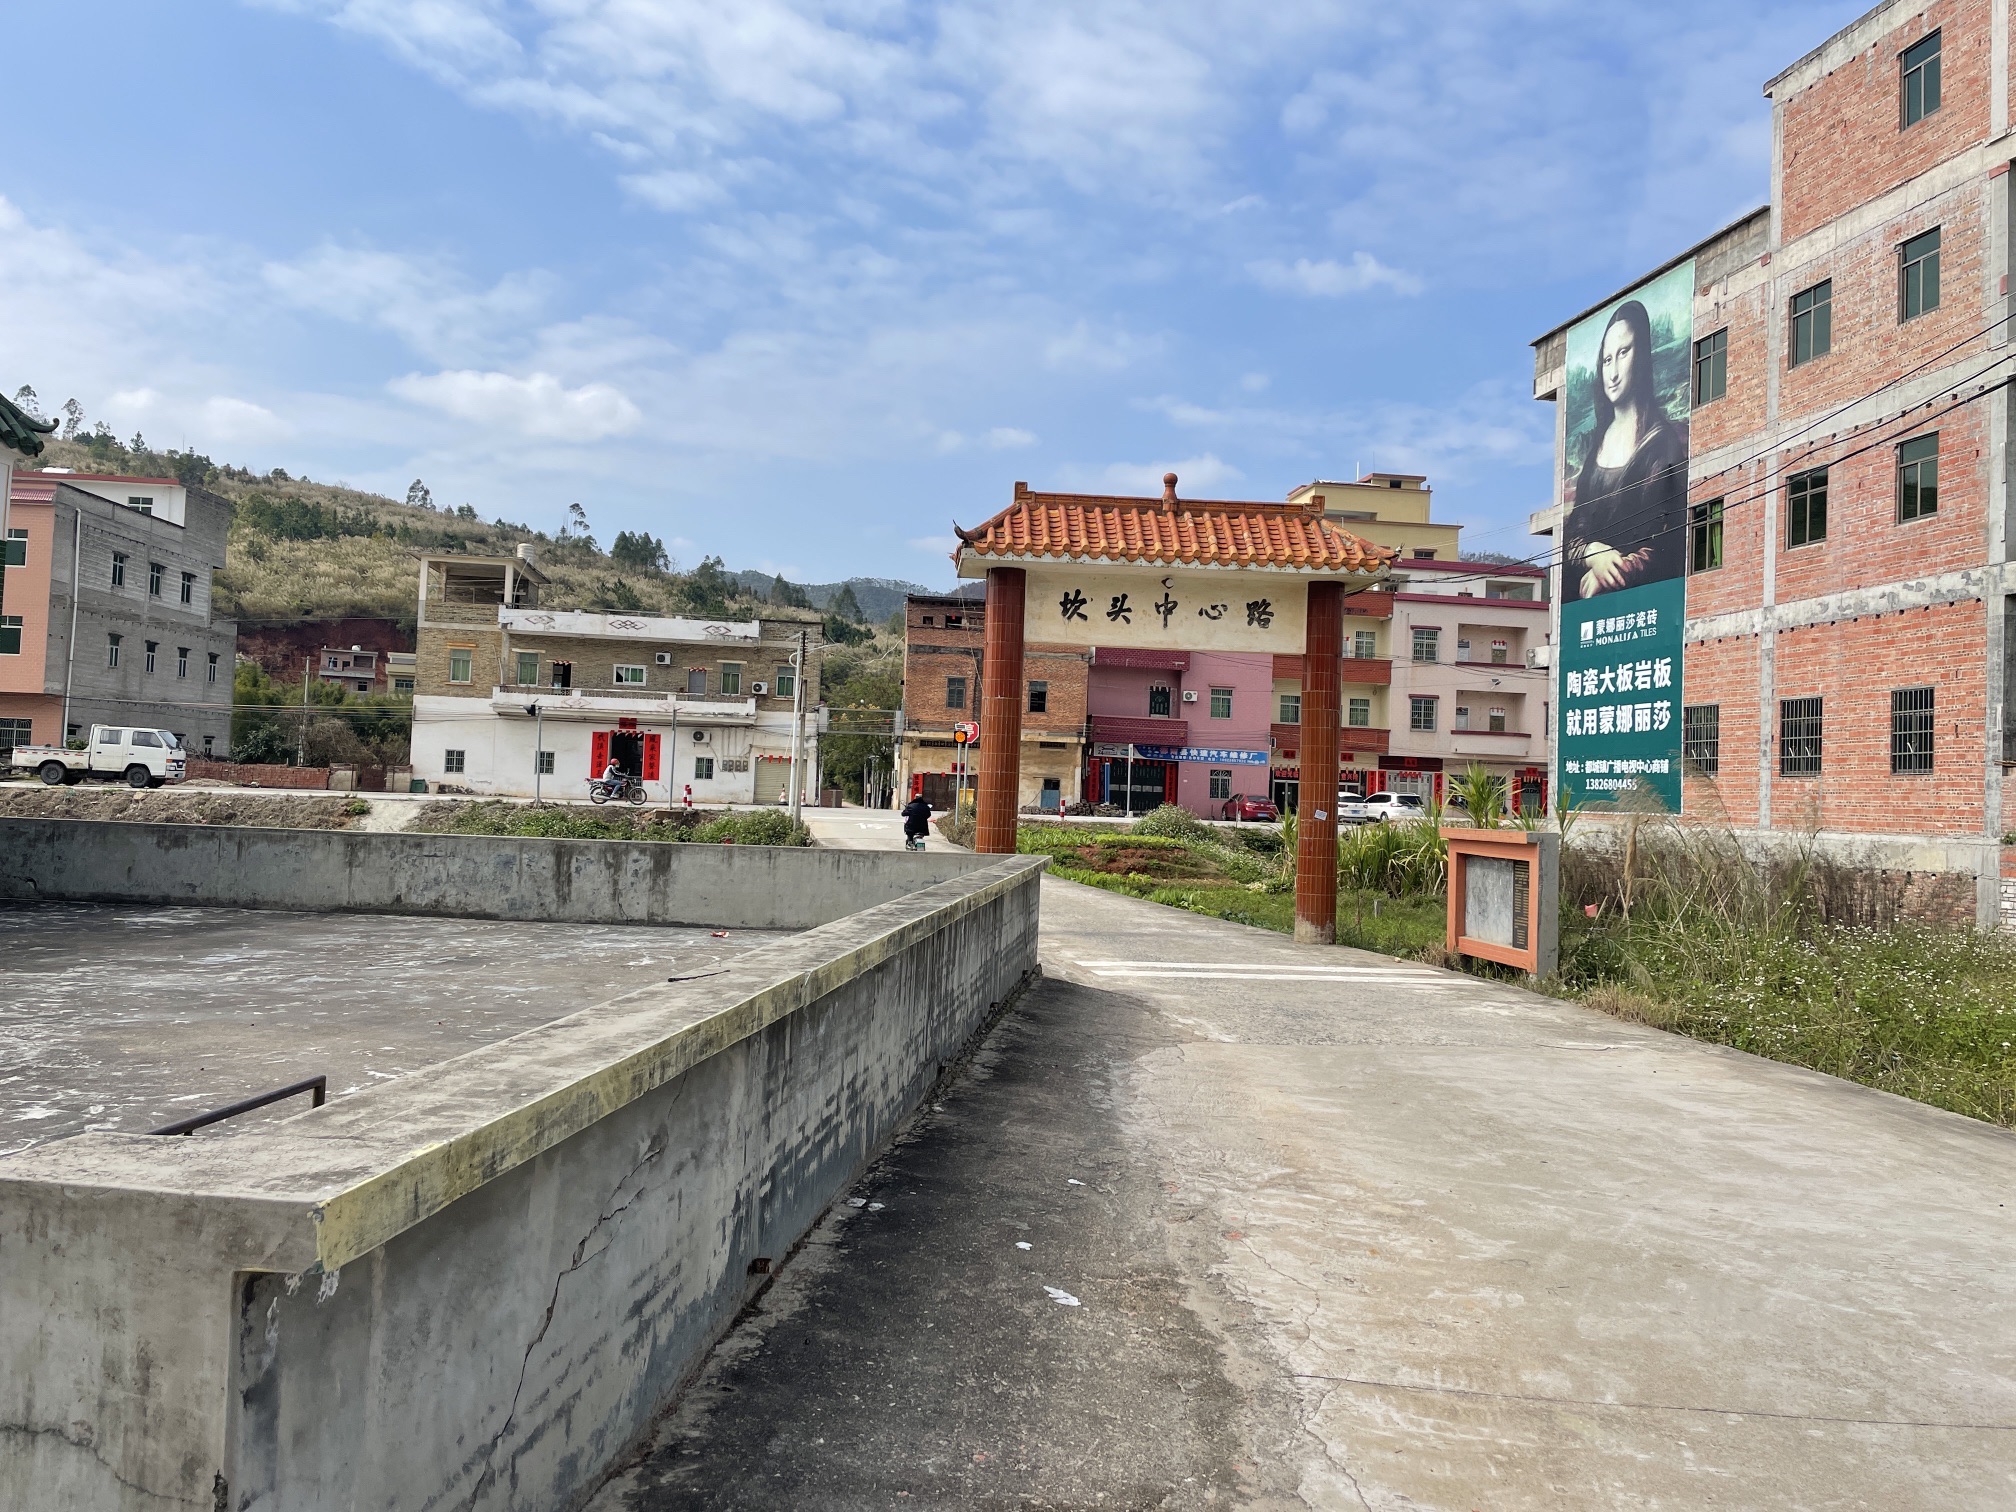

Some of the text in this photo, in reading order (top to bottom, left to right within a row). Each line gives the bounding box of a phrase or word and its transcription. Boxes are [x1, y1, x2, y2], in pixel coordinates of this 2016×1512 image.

[1059, 588, 1275, 629] 坎头中心路
[1596, 608, 1658, 635] 蒙娜丽莎瓷砖
[1595, 631, 1639, 646] MONALISA
[1640, 627, 1657, 638] TILES
[1566, 657, 1672, 698] 陶瓷大板岩板
[1566, 700, 1671, 736] 就用蒙娜丽莎
